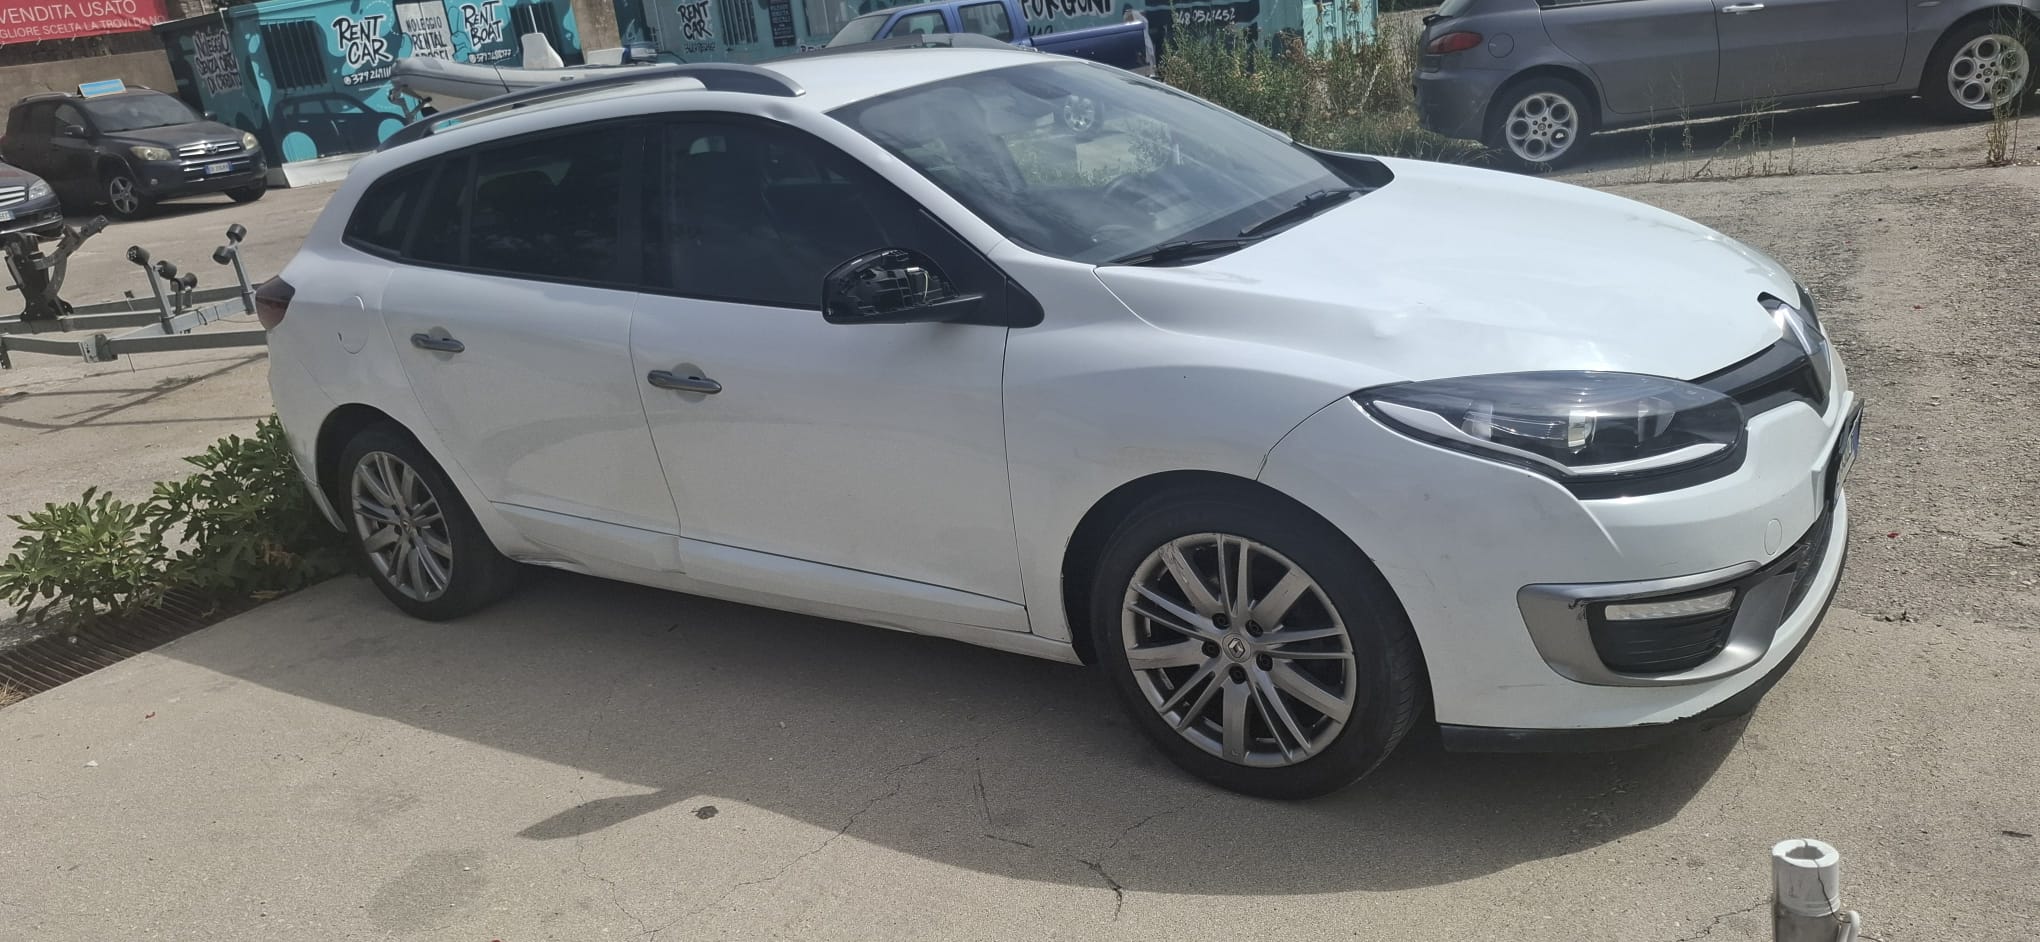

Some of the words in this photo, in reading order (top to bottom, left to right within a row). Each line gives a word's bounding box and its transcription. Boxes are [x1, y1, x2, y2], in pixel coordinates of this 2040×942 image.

[0, 4, 77, 24] VENDITA
[79, 0, 137, 17] USATO
[461, 0, 500, 29] RENT
[677, 0, 708, 23] RENT
[42, 22, 81, 35] SCELTA
[83, 20, 99, 31] LA
[332, 14, 385, 49] RENT
[405, 16, 442, 32] NOLEGGIO
[470, 19, 502, 47] BOAT
[683, 19, 713, 40] CAR
[347, 38, 391, 65] CAR
[411, 31, 448, 50] RENTAL
